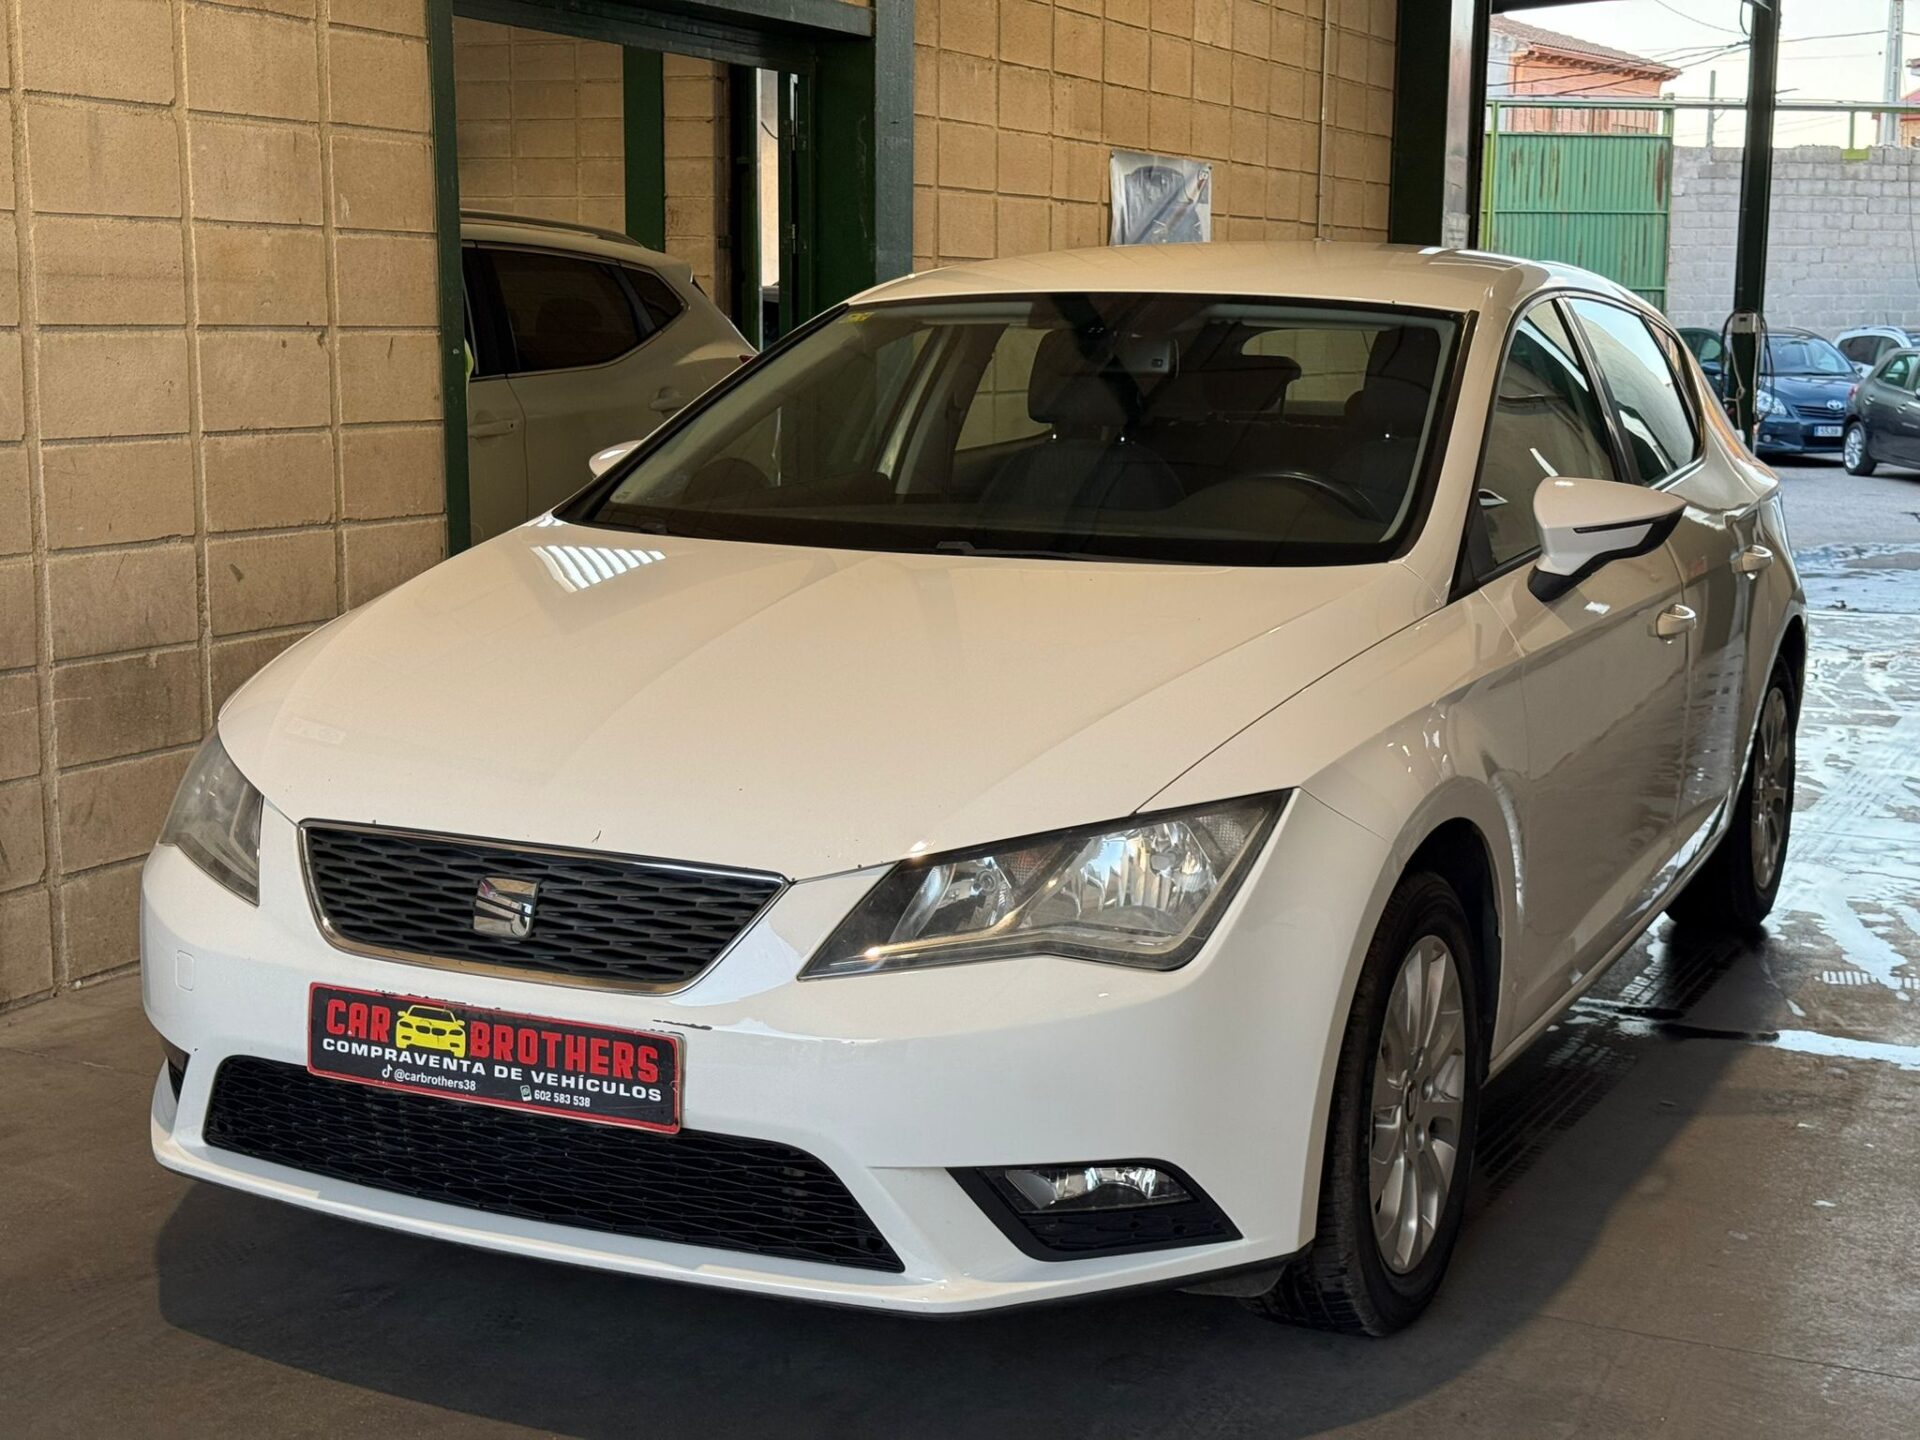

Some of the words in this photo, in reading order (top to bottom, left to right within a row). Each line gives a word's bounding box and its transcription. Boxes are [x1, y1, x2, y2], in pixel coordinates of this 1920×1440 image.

[326, 999, 390, 1043] CAR
[470, 1020, 659, 1083] BROTHERS
[322, 1038, 486, 1075] COMPRAVENTA
[494, 1064, 522, 1081] DE
[530, 1070, 662, 1102] VEHÍCULOS
[394, 1068, 477, 1092] @carbrothers38
[534, 1089, 552, 1101] 602
[553, 1092, 571, 1105] 583
[573, 1096, 591, 1108] 538
